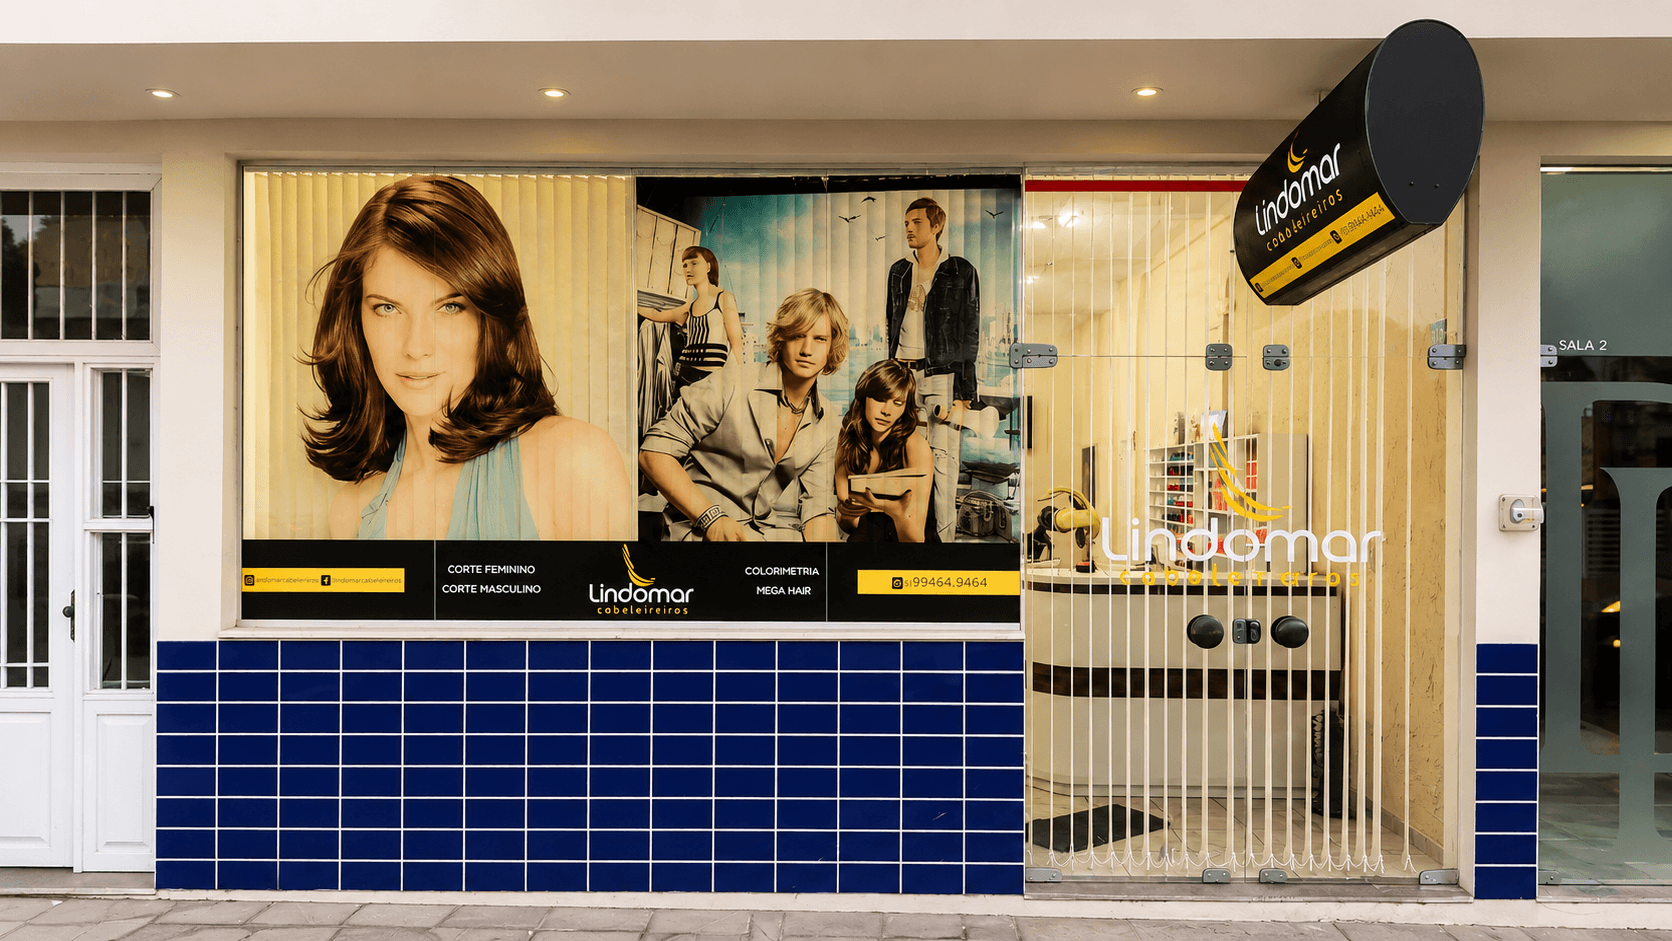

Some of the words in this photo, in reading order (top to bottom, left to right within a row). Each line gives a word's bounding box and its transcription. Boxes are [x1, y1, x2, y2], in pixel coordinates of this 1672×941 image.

[1255, 142, 1341, 236] Lindomar
[1558, 339, 1595, 351] SALA
[1599, 339, 1608, 351] 2
[1101, 517, 1382, 563] Lindomar
[447, 564, 483, 575] CORTE
[484, 564, 536, 575] FEMININO
[744, 566, 820, 577] COLORIMETRIA
[441, 584, 477, 594] CORTE
[479, 584, 542, 594] MASCULINO
[588, 583, 695, 604] Lindomar
[756, 585, 786, 596] MEGA
[787, 585, 812, 596] HAIR
